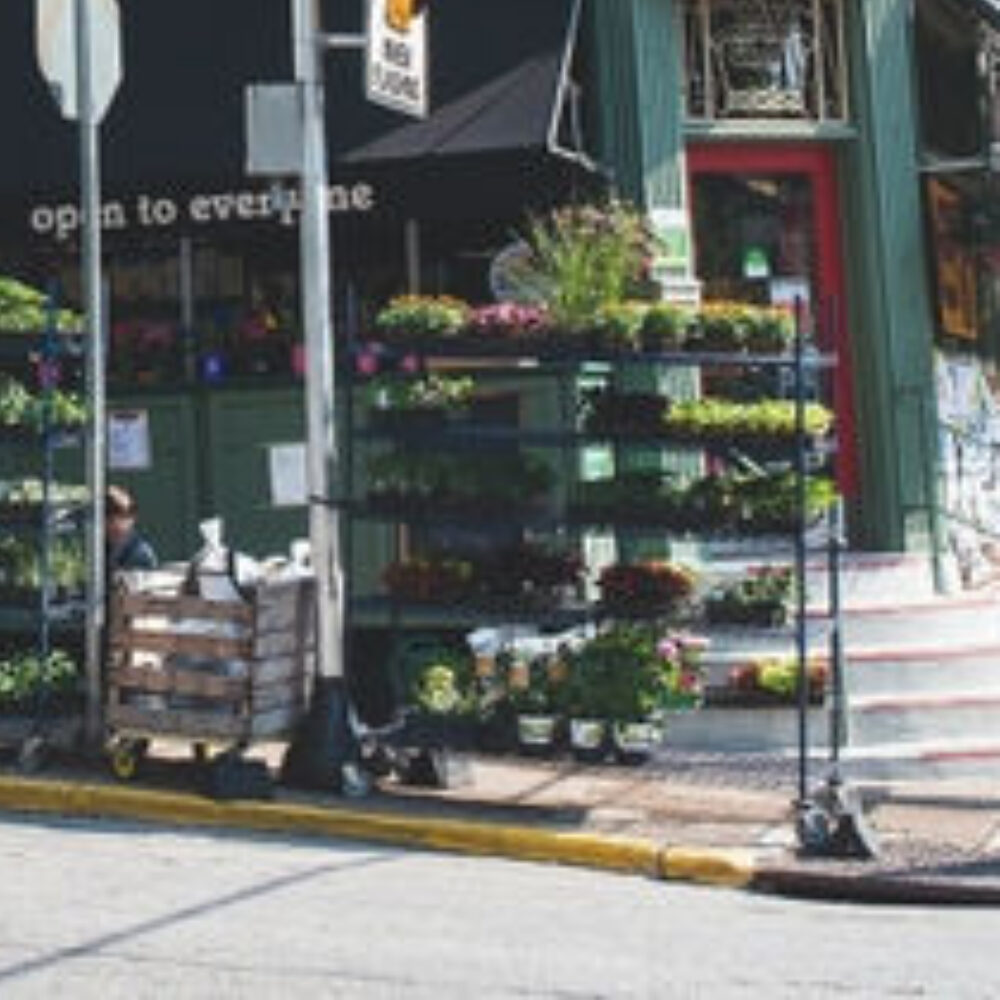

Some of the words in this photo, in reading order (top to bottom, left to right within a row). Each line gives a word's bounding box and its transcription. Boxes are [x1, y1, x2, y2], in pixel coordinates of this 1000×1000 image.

[31, 198, 127, 240] opn
[136, 194, 176, 225] to
[188, 180, 374, 225] everyne
